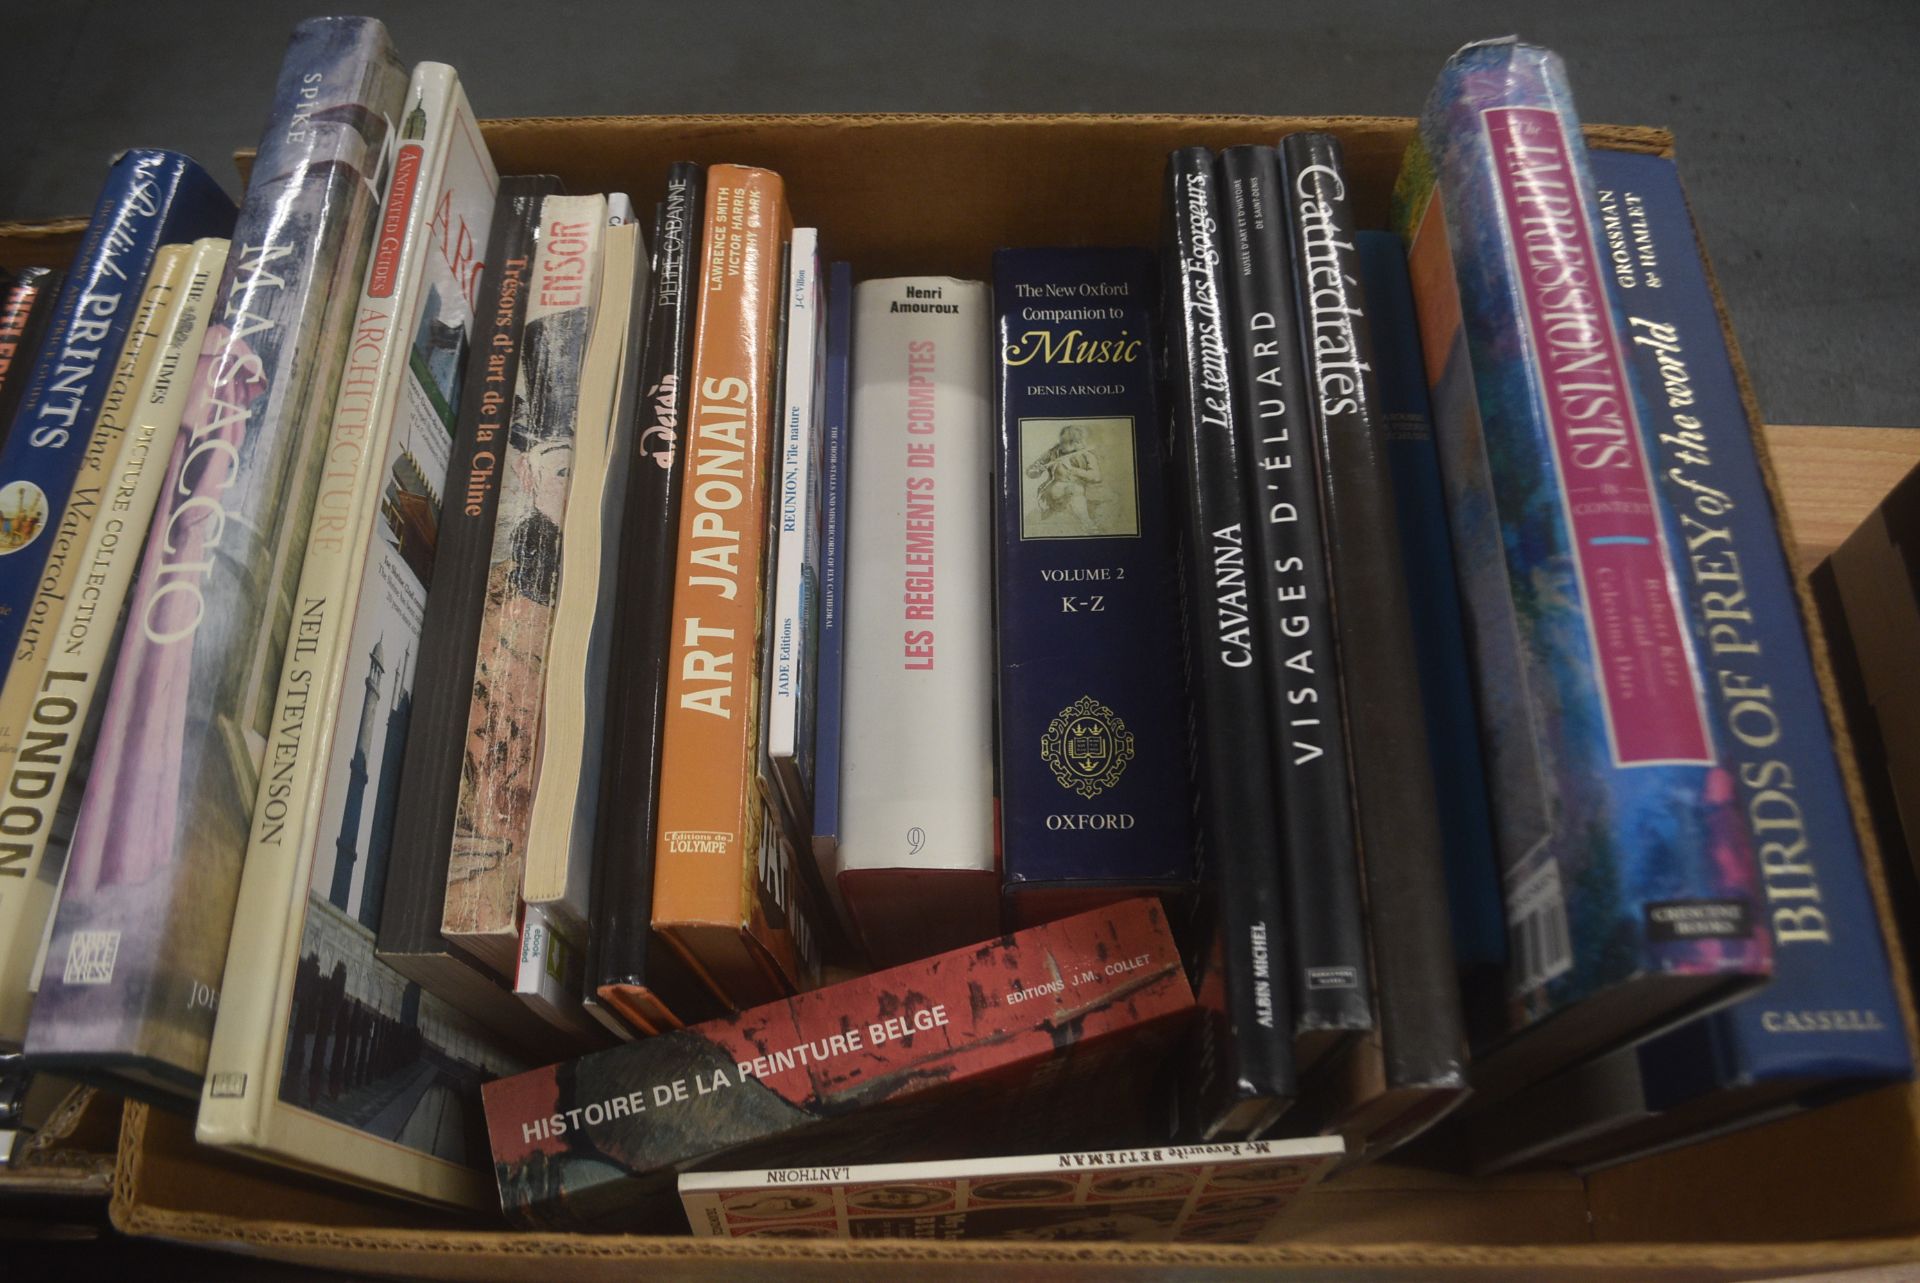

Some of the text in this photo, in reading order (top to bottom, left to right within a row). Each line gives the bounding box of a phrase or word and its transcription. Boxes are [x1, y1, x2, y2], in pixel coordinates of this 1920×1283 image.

[286, 72, 323, 145] SPIKE
[385, 151, 418, 233] ANNOTATED
[663, 178, 687, 252] CABANNE
[710, 187, 730, 292] LAWRENCE SMITH
[727, 187, 746, 277] VICTOR HARRIS
[1598, 189, 1637, 289] GROSSMAN
[1624, 191, 1659, 267] HAMLET
[372, 237, 400, 292] GUIDES
[538, 220, 592, 309] ENSOR
[1015, 282, 1129, 298] The New Oxford
[890, 300, 960, 314] Amouroux
[905, 286, 943, 300] Henri
[1022, 306, 1124, 324] Companion to
[1297, 164, 1373, 419] Cathédrales
[29, 291, 122, 450] PRINTS
[1004, 329, 1142, 367] Music
[464, 255, 529, 517] Trésors d'art de la Chine
[906, 339, 936, 435] COMPTES
[1027, 384, 1125, 396] DENIS ARNOLD
[788, 405, 800, 440] nature
[829, 426, 839, 442] THE
[1201, 396, 1229, 430] Le
[143, 240, 296, 645] MASACCIO
[906, 442, 936, 468] DE
[17, 284, 174, 664] Understanding Watercolours
[783, 466, 799, 533] REUNION,
[828, 492, 838, 507] AND
[680, 375, 750, 720] ART JAPONAIS
[826, 507, 837, 558] MISERICORDS
[1251, 310, 1324, 767] VISAGES D'ÉLUARD
[0, 270, 210, 878] THE TIMES PICTURE COLLECTION LONDON
[259, 306, 388, 846] ARCHITECTURE NEIL STEVENSON
[827, 558, 836, 569] OF
[827, 569, 836, 583] ELY
[1040, 567, 1126, 581] VOLUME 2
[825, 583, 836, 630] CATHEDRAL
[1061, 596, 1105, 614] K-Z
[1213, 521, 1254, 669] CAVANNA
[904, 629, 935, 671] LES
[1627, 315, 1831, 945] BIRDS OF PREY of the world
[777, 617, 792, 698] JADE Editions
[670, 840, 727, 854] L'OLYMPE
[906, 826, 926, 856] 9
[1045, 814, 1135, 831] OXFORD
[521, 923, 533, 963] included
[532, 928, 541, 958] ebook
[1006, 953, 1151, 1006] EDITIONS J.M. COLLET
[1250, 921, 1275, 1028] ALBIN MICHEL
[1762, 1009, 1886, 1034] CASSELL
[521, 1004, 950, 1144] HISTOIRE DE LA PEINTURE BELGE
[766, 1166, 851, 1184] LANTHORN
[1058, 1141, 1272, 1168] My Favourite BETJEMAN
